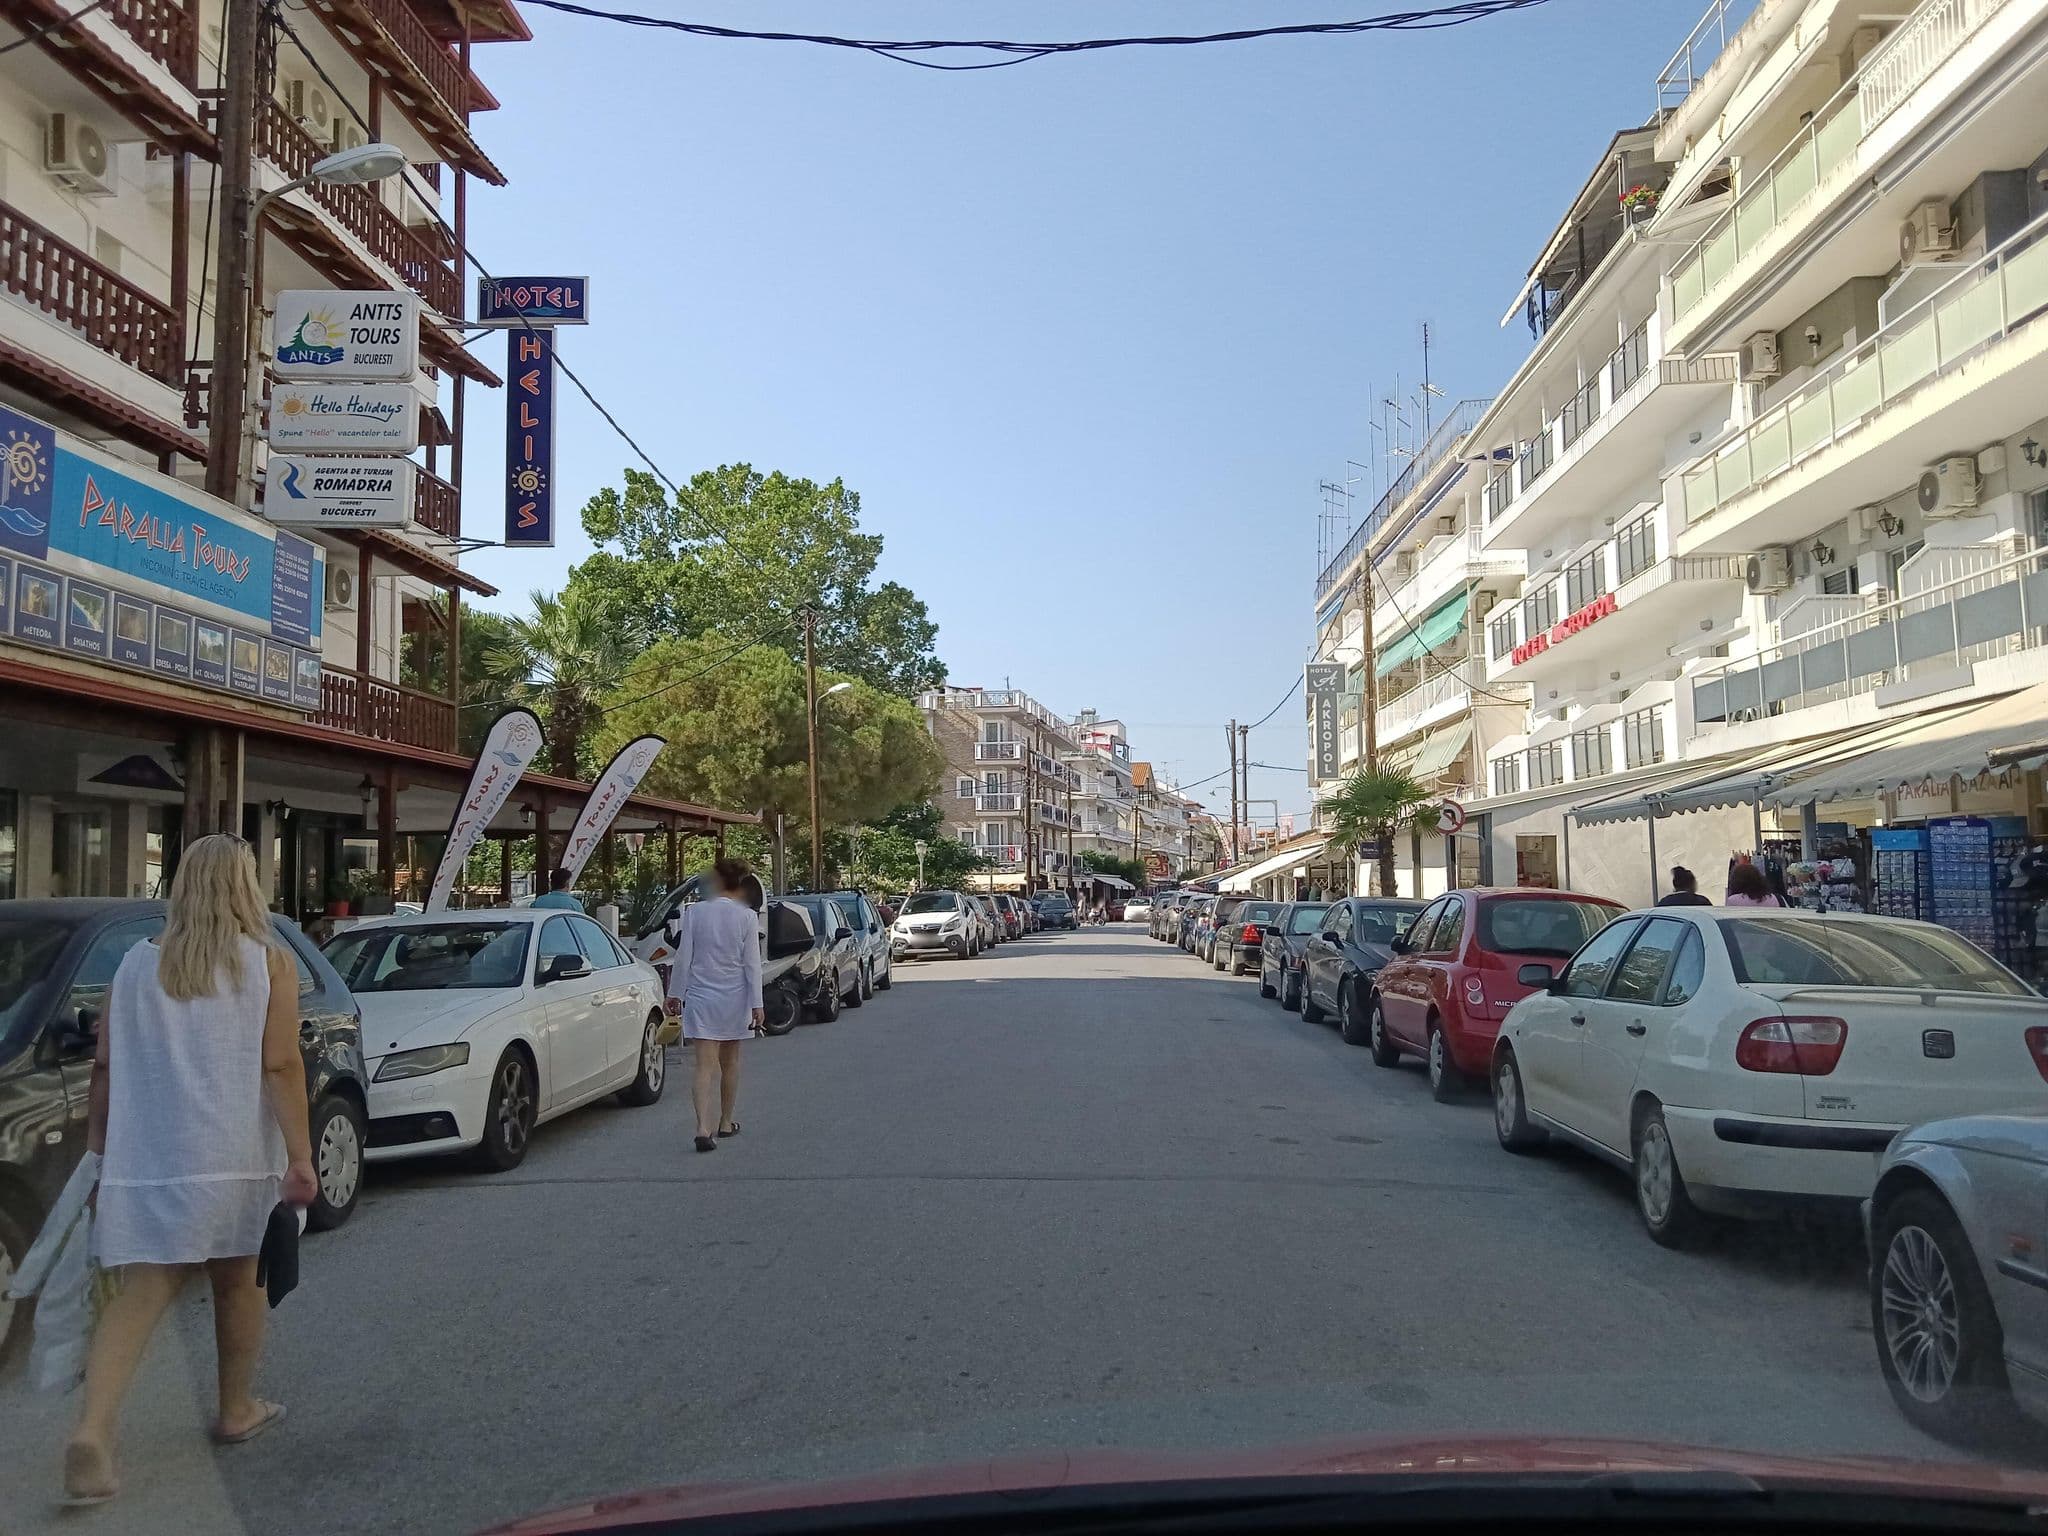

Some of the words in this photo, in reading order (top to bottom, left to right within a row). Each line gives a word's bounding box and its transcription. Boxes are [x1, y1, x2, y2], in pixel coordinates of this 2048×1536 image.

[494, 286, 580, 309] HOTEL
[350, 304, 403, 321] ANTTS
[350, 328, 401, 345] TOURS
[289, 350, 331, 363] ANTTS
[353, 354, 393, 365] BUCURESTI
[311, 395, 342, 413] Hello
[347, 395, 403, 420] Holidays
[278, 429, 303, 438] Spune
[337, 429, 381, 437] vacantelor
[315, 467, 349, 475] AGENTIA
[313, 478, 392, 492] ROMADRIA
[321, 507, 376, 517] BUCURESTI
[79, 472, 187, 563] PARALIA
[191, 523, 250, 584] TOURS
[140, 558, 181, 582] INCOMING
[182, 571, 209, 591] TRAVEL
[209, 582, 238, 599] AGENCY
[23, 625, 52, 639] METEORA
[1322, 698, 1333, 774] AKROPOL
[466, 764, 499, 812] TOURS
[1494, 1000, 1516, 1008] MICR
